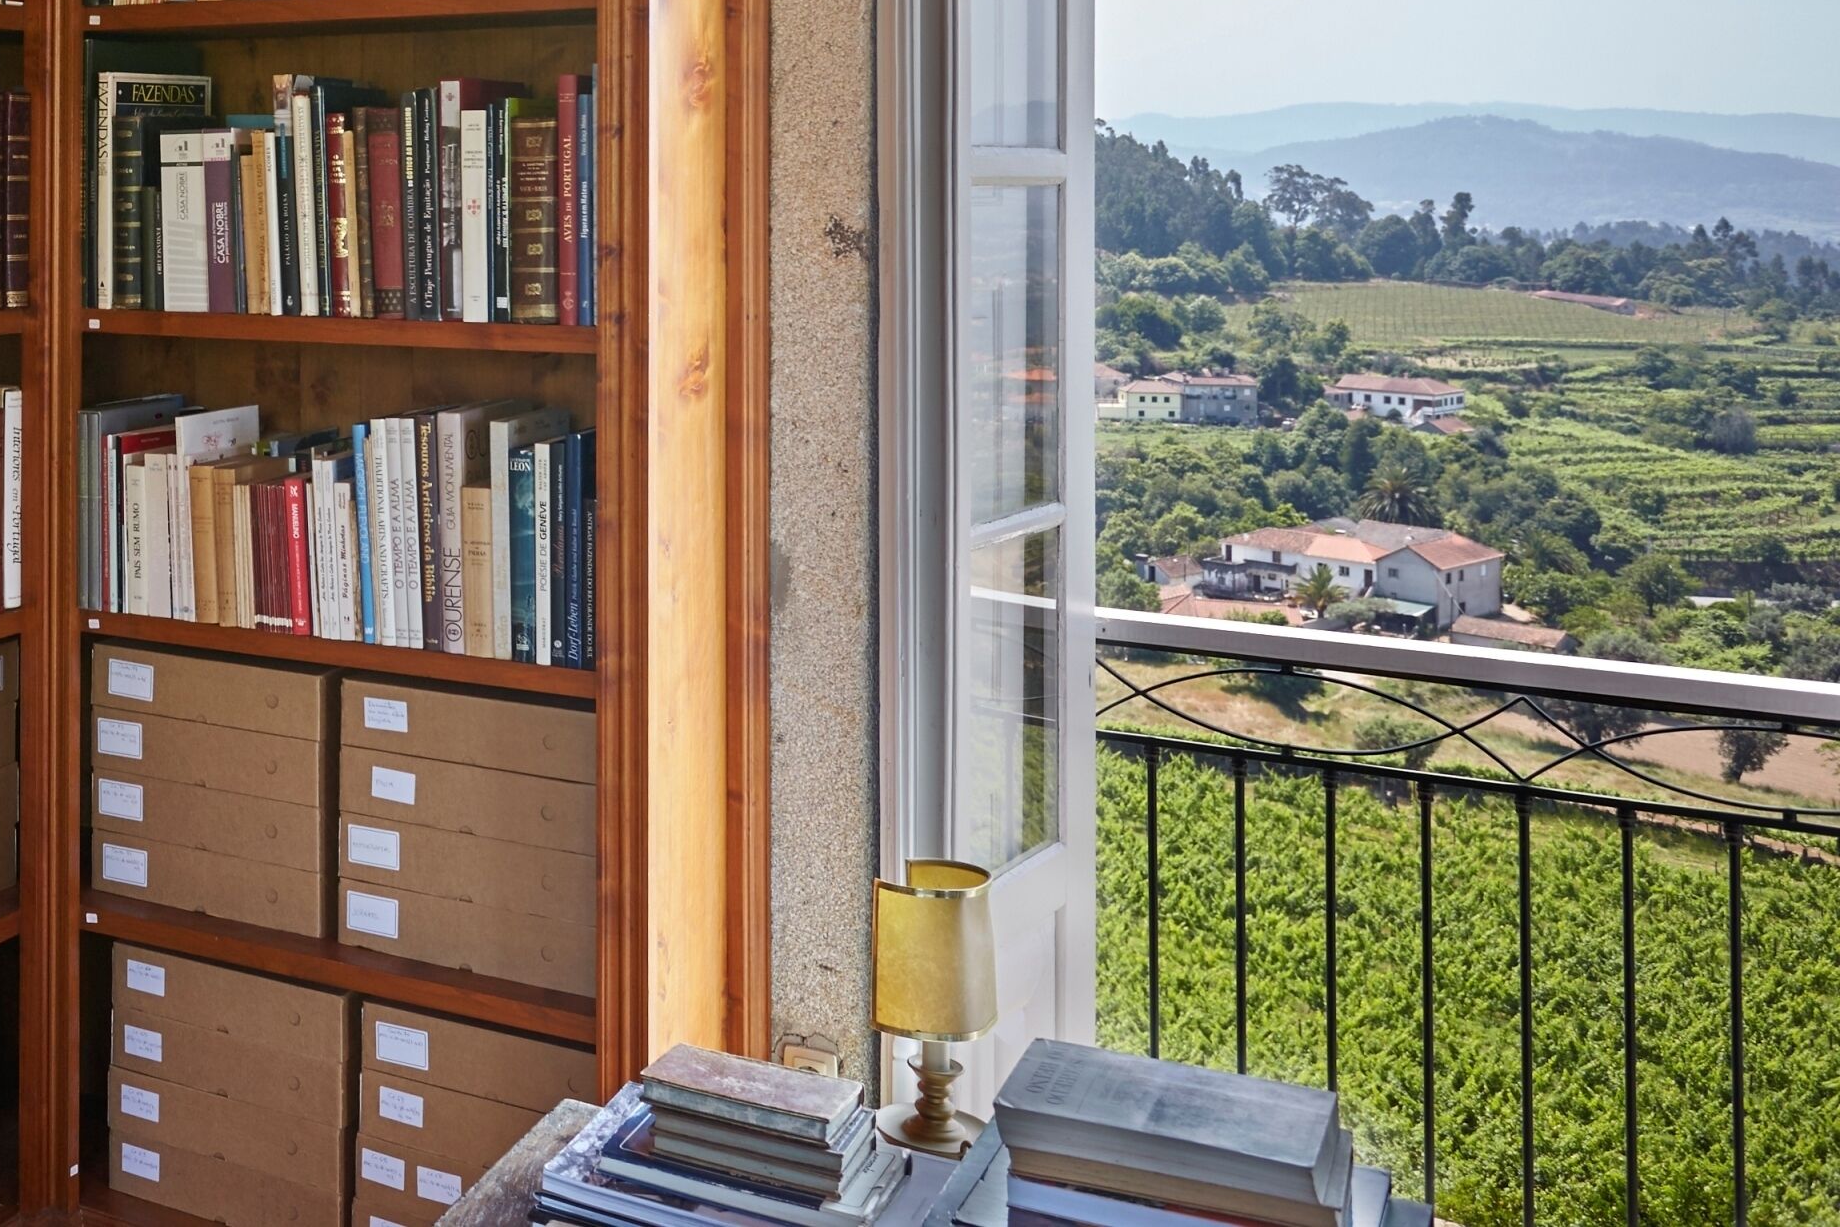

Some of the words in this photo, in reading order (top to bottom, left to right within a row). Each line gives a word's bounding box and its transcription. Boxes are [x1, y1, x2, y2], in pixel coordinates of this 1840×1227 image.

[131, 83, 196, 104] FAZENDAS
[98, 79, 109, 159] FAZENDAS
[405, 107, 413, 146] MANEIRISMO
[423, 123, 431, 141] Riding
[563, 135, 572, 198] PORTUGAL
[406, 188, 415, 229] COIMBRA
[422, 179, 434, 219] Equitação
[565, 201, 572, 212] DE
[215, 202, 225, 235] NOBRE
[424, 223, 433, 232] de
[563, 214, 572, 243] AVES
[581, 214, 589, 238] Figuras
[217, 237, 226, 264] CASA
[407, 231, 415, 243] DE
[408, 245, 417, 296] ESCULTURA
[424, 235, 435, 276] Português
[424, 279, 435, 300] Traje
[424, 300, 433, 309] O
[420, 422, 432, 477] Tesouros
[443, 432, 455, 503] MONUMENTAL
[374, 456, 384, 517] TRADITIONAL
[390, 478, 400, 512] ALMA
[404, 478, 415, 512] ALMA
[291, 503, 300, 539] MANUELINO
[390, 514, 400, 523] A
[405, 515, 415, 524] A
[421, 479, 434, 543] Artísticos
[444, 506, 456, 531] GUIA
[377, 519, 385, 542] ARTS
[379, 543, 387, 562] AND
[392, 536, 403, 576] TEMPO
[406, 536, 418, 577] TEMPO
[423, 544, 434, 561] da
[341, 563, 349, 599] Páginas
[380, 563, 389, 599] CRAFTS
[394, 579, 404, 589] O
[408, 580, 419, 590] O
[423, 564, 435, 603] Bíblia
[442, 547, 462, 643] OURENSE
